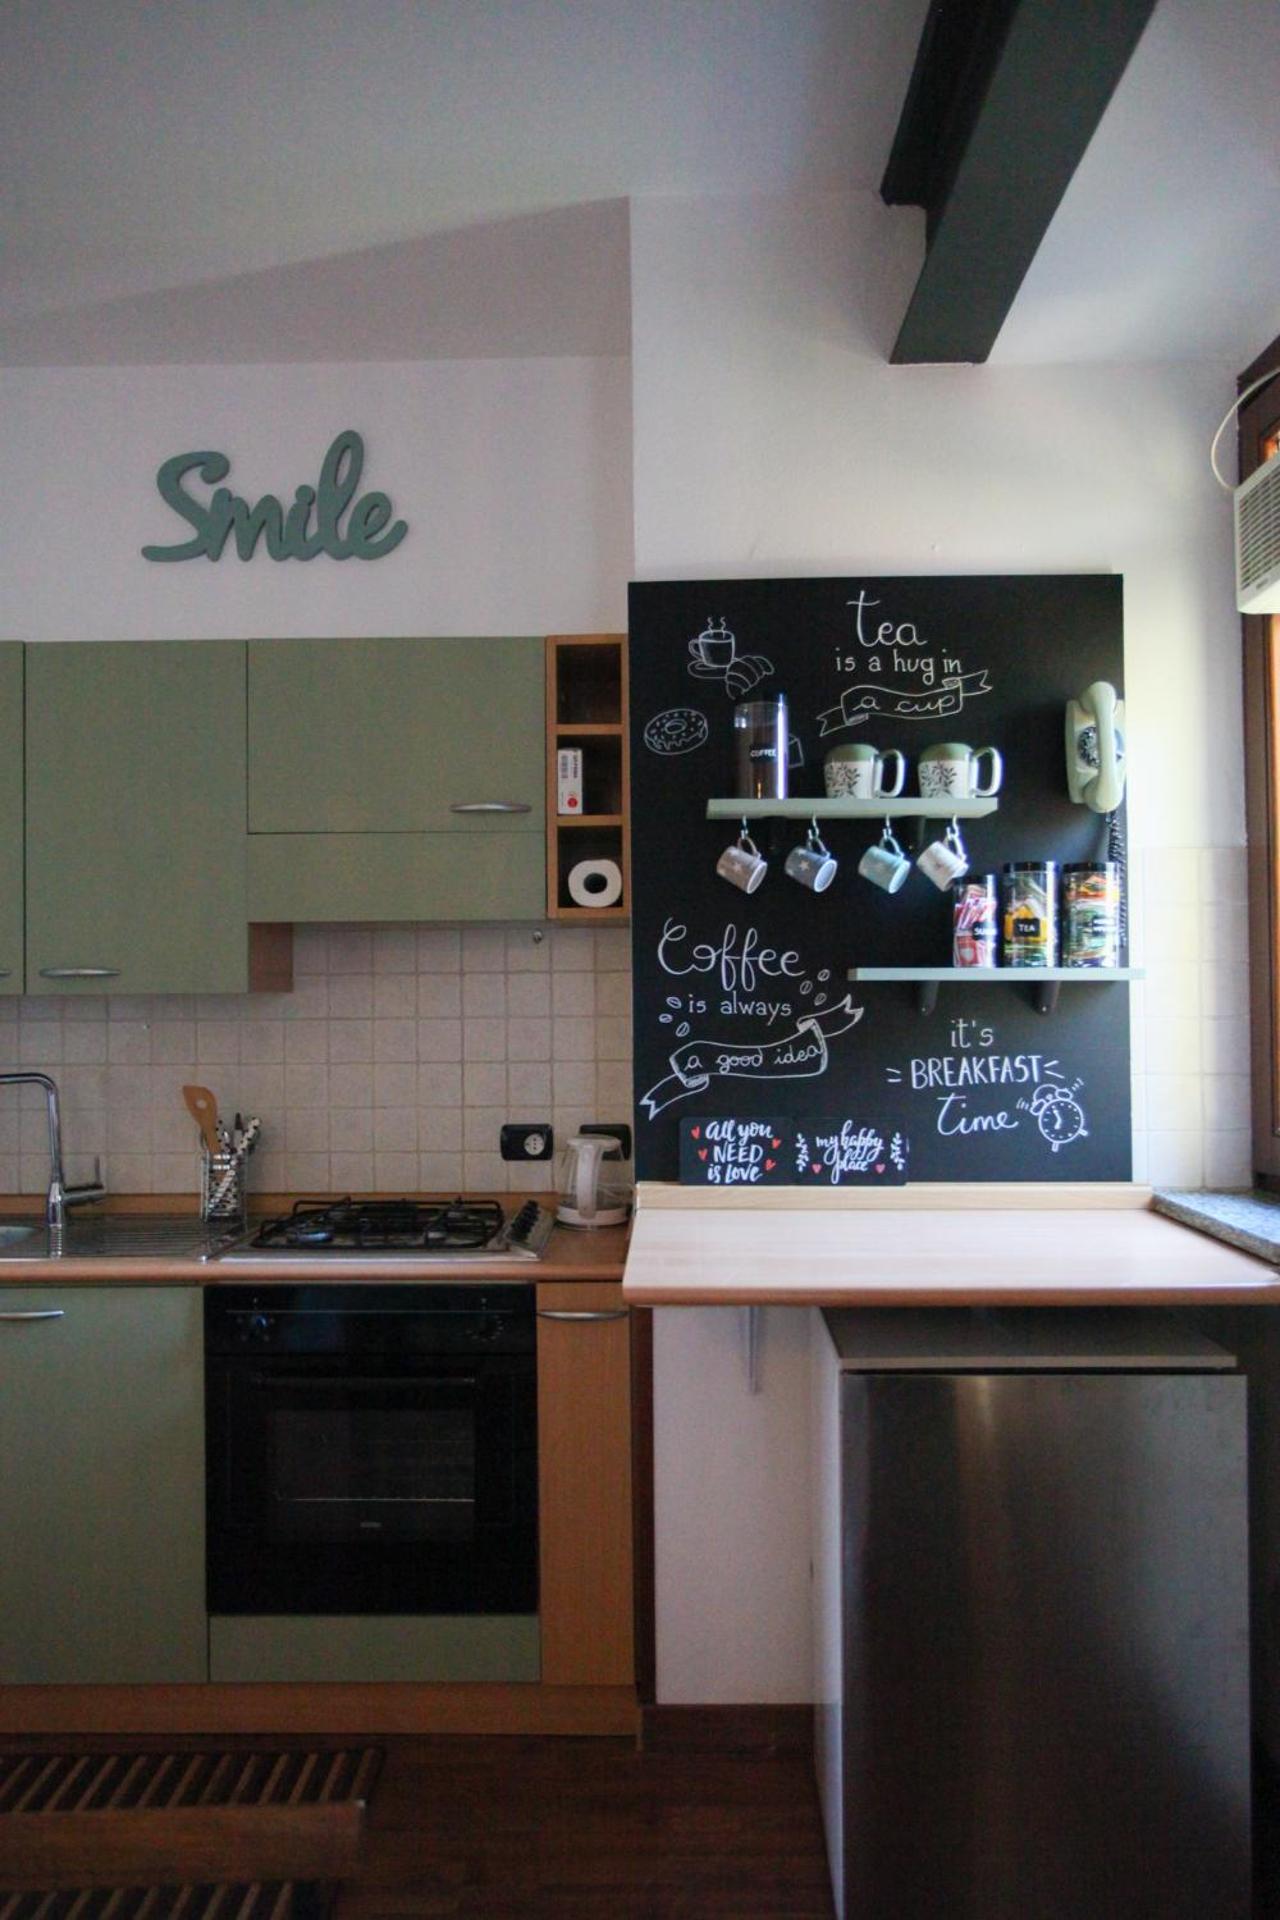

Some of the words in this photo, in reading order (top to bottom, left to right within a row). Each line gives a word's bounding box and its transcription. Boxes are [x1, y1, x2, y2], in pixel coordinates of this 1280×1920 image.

[141, 429, 409, 562] Smile
[846, 590, 928, 647] tea
[835, 647, 856, 672] is
[868, 656, 882, 673] a
[893, 649, 935, 686] hug
[941, 648, 963, 674] in
[852, 696, 881, 711] a
[894, 695, 956, 714] cup
[1018, 925, 1036, 933] TEA
[657, 916, 806, 992] Coffee
[688, 993, 708, 1014] is
[720, 990, 792, 1026] always
[951, 1018, 994, 1048] it's
[684, 1055, 703, 1072] a
[715, 1047, 764, 1074] good
[774, 1045, 823, 1066] idea
[911, 1055, 1043, 1090] BREAKFAST
[737, 1121, 774, 1147] you
[816, 1134, 840, 1166] my
[838, 1119, 884, 1160] happy
[713, 1143, 764, 1164] NEED
[828, 1150, 869, 1185] place
[707, 1164, 721, 1183] is
